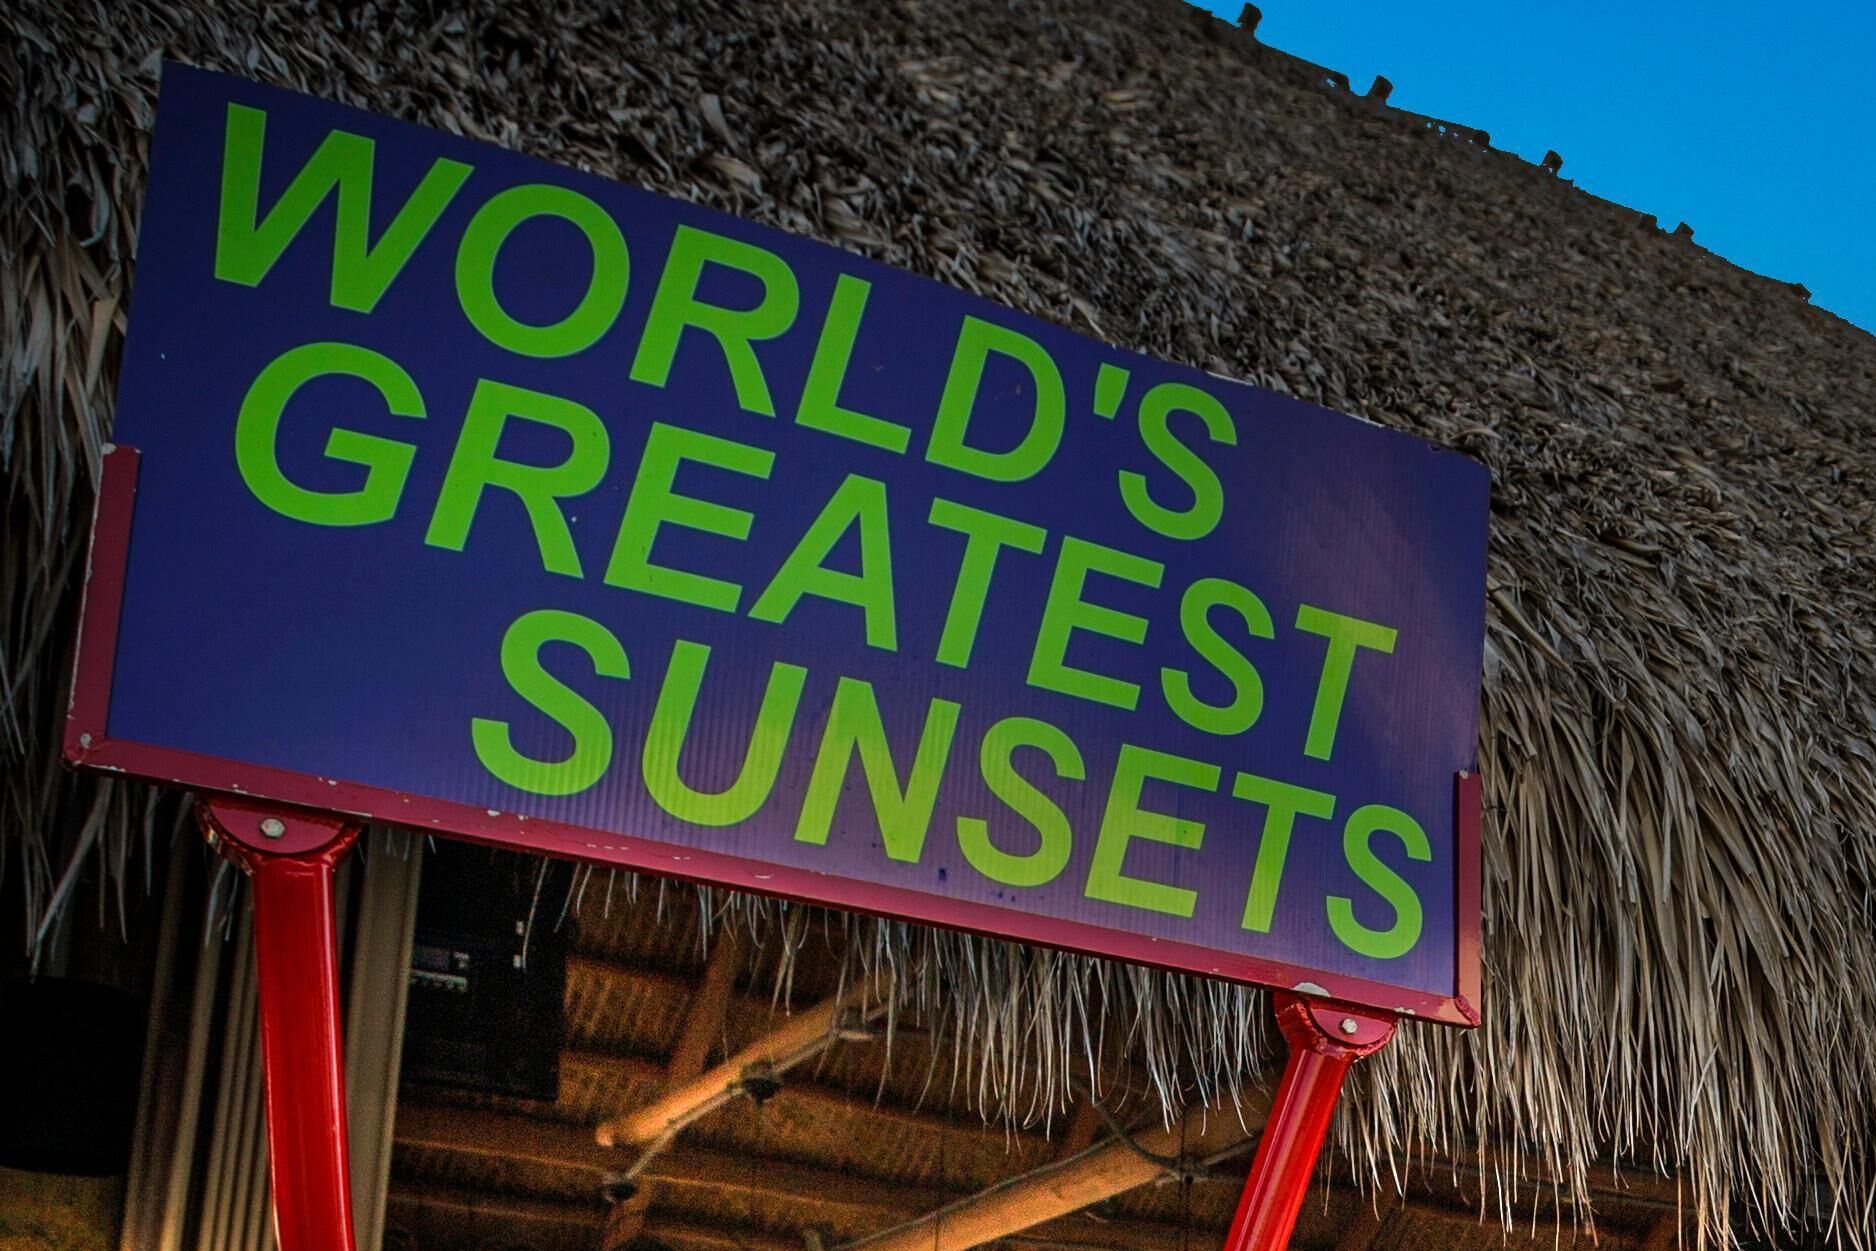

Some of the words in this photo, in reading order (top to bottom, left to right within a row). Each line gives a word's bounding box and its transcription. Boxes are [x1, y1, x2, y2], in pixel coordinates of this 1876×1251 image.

[214, 102, 1237, 541] WORLD'S
[235, 342, 1398, 760] GREATEST
[472, 610, 1431, 959] SUNSETS
